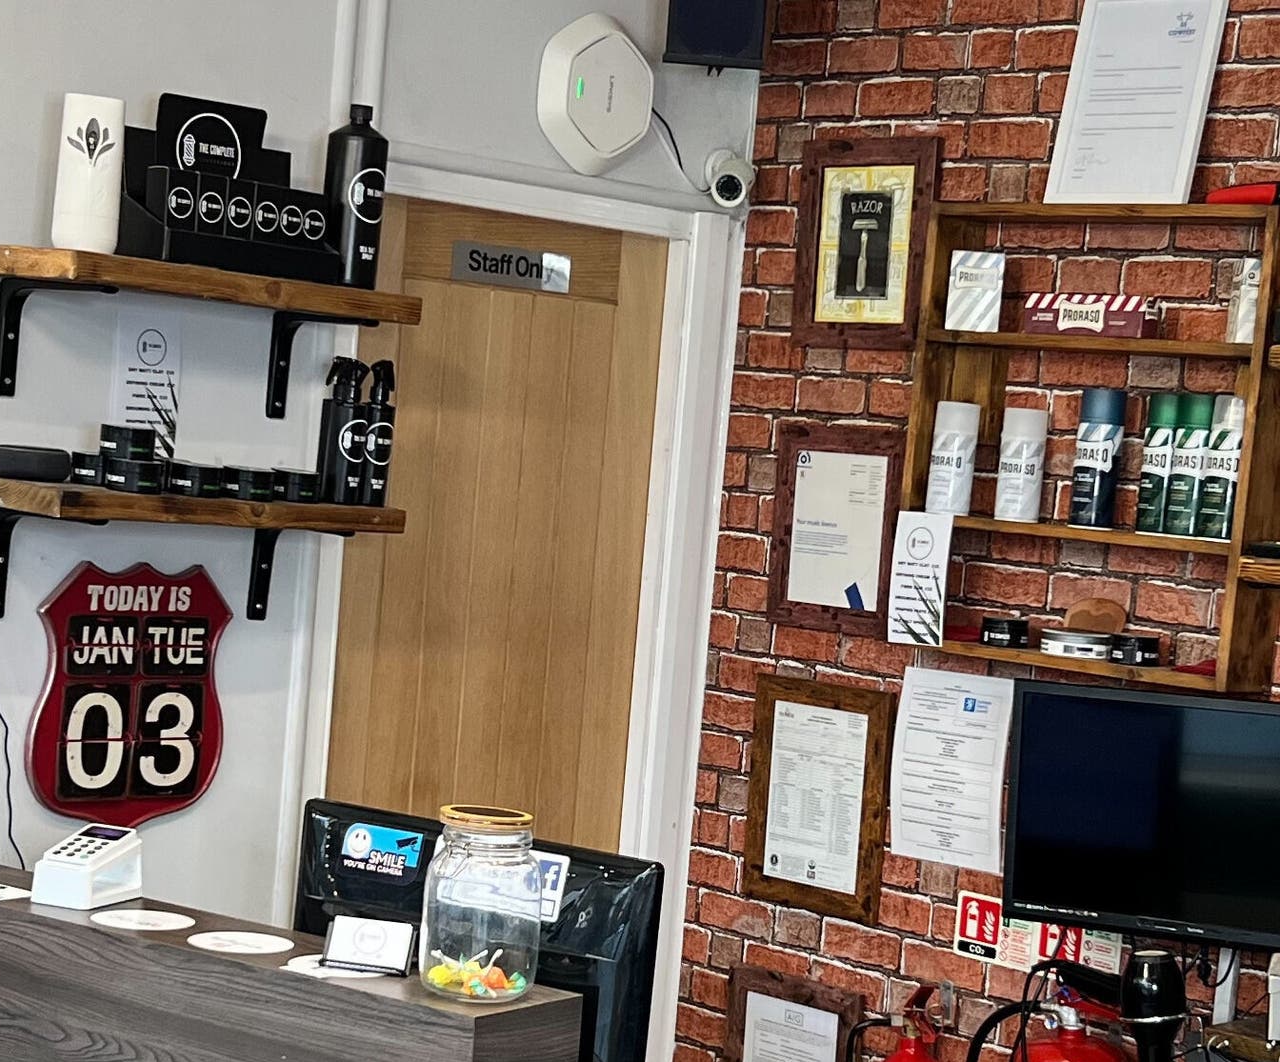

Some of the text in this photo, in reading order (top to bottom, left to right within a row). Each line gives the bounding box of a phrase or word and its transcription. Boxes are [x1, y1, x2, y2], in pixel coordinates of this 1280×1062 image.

[850, 200, 883, 215] RAZOR
[468, 249, 514, 275] Staff
[1062, 308, 1100, 324] PRORASO
[87, 585, 192, 612] TODAY IS
[73, 626, 205, 665] JAN TUE
[368, 850, 406, 869] SMILE
[366, 863, 377, 871] ON
[377, 865, 403, 876] CAMERA
